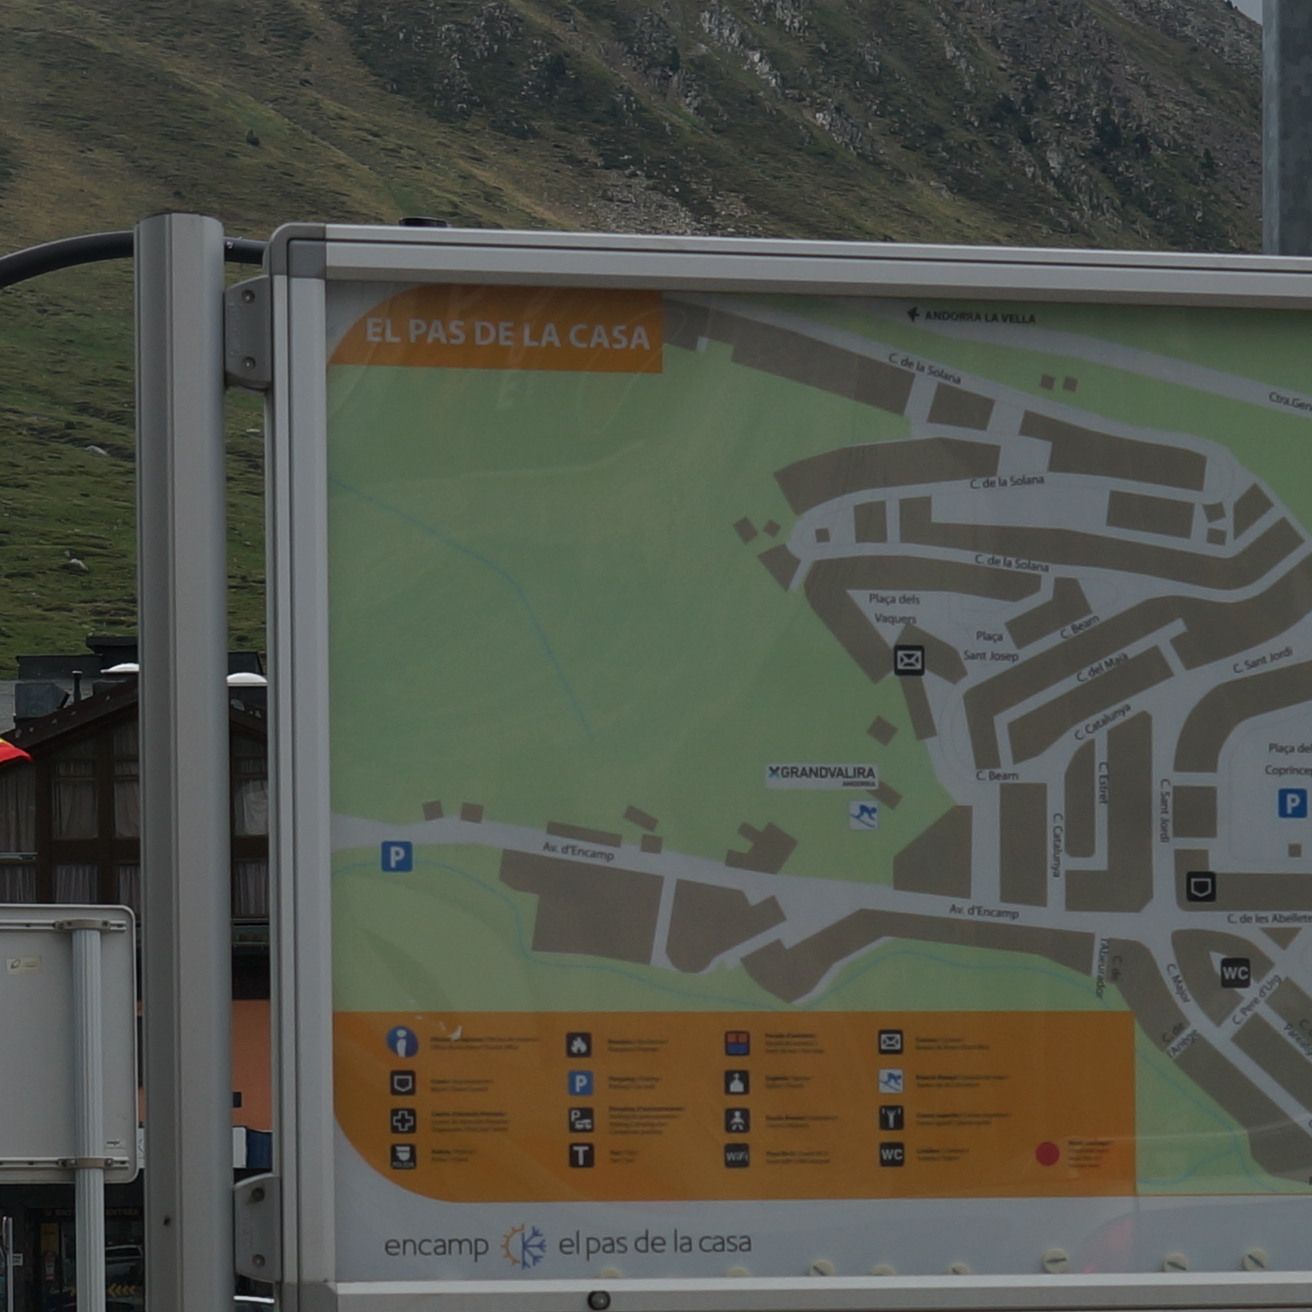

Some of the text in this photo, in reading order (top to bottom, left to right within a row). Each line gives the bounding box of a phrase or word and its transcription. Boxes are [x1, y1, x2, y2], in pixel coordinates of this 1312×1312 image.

[925, 310, 1036, 324] ANDORRA LA VELLA
[366, 318, 650, 350] EL PAS DE LA CASA
[889, 352, 962, 385] C. de la Solana
[869, 593, 920, 606] Plaça dels
[976, 631, 1003, 644] Plaça
[964, 649, 1019, 663] Sant Josep
[780, 766, 876, 781] GRANDVALIRA
[950, 904, 1019, 920] Av. d'Encamp
[1227, 914, 1238, 925] C.
[1240, 914, 1253, 925] de
[1255, 914, 1268, 925] les
[385, 1235, 489, 1261] encamp
[559, 1229, 752, 1263] el pas de la casa
